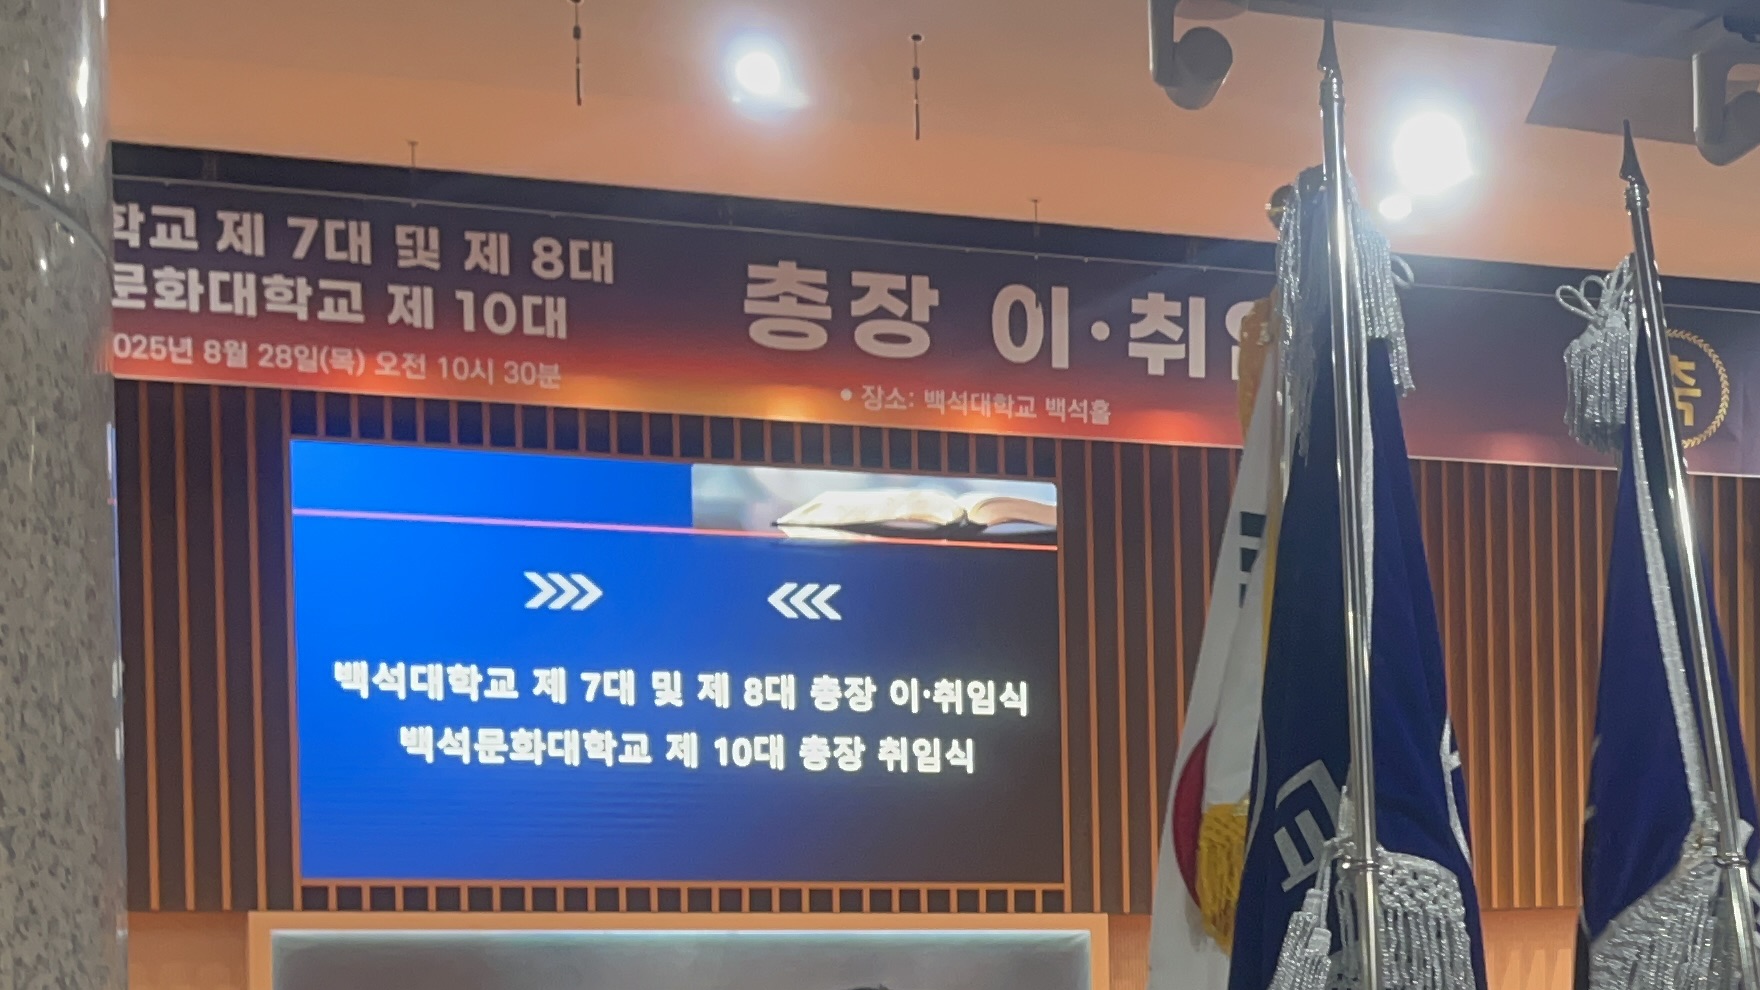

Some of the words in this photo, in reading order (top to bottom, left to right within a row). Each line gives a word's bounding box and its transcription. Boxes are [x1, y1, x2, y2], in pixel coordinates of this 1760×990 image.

[216, 210, 265, 257] 제
[286, 216, 372, 265] 7대
[395, 224, 441, 271] 및
[464, 230, 510, 276] 제
[531, 237, 614, 284] 8대
[387, 284, 434, 330] 제
[455, 290, 567, 339] 10대
[743, 260, 940, 359] 총장
[203, 339, 248, 369] 8월
[257, 342, 366, 376] 28일(목)
[374, 350, 426, 381] 오전
[437, 355, 494, 386] 10시
[503, 360, 561, 390] 30분
[861, 384, 915, 412] 장소:
[924, 389, 1038, 418] 백석대학교
[1045, 397, 1112, 426] 백석홀
[333, 660, 520, 702] 백석대학교
[532, 666, 567, 705] 제
[580, 668, 636, 707] 7대
[651, 670, 684, 708] 및
[697, 671, 730, 709] 제
[743, 673, 796, 711] 8대
[809, 674, 878, 713] 총장
[889, 677, 1028, 717] 이·취임식
[399, 725, 653, 768] 백석문화대학교
[665, 731, 699, 769] 제
[713, 733, 785, 771] 10대
[798, 734, 867, 772] 총장
[877, 736, 974, 774] 취임식
